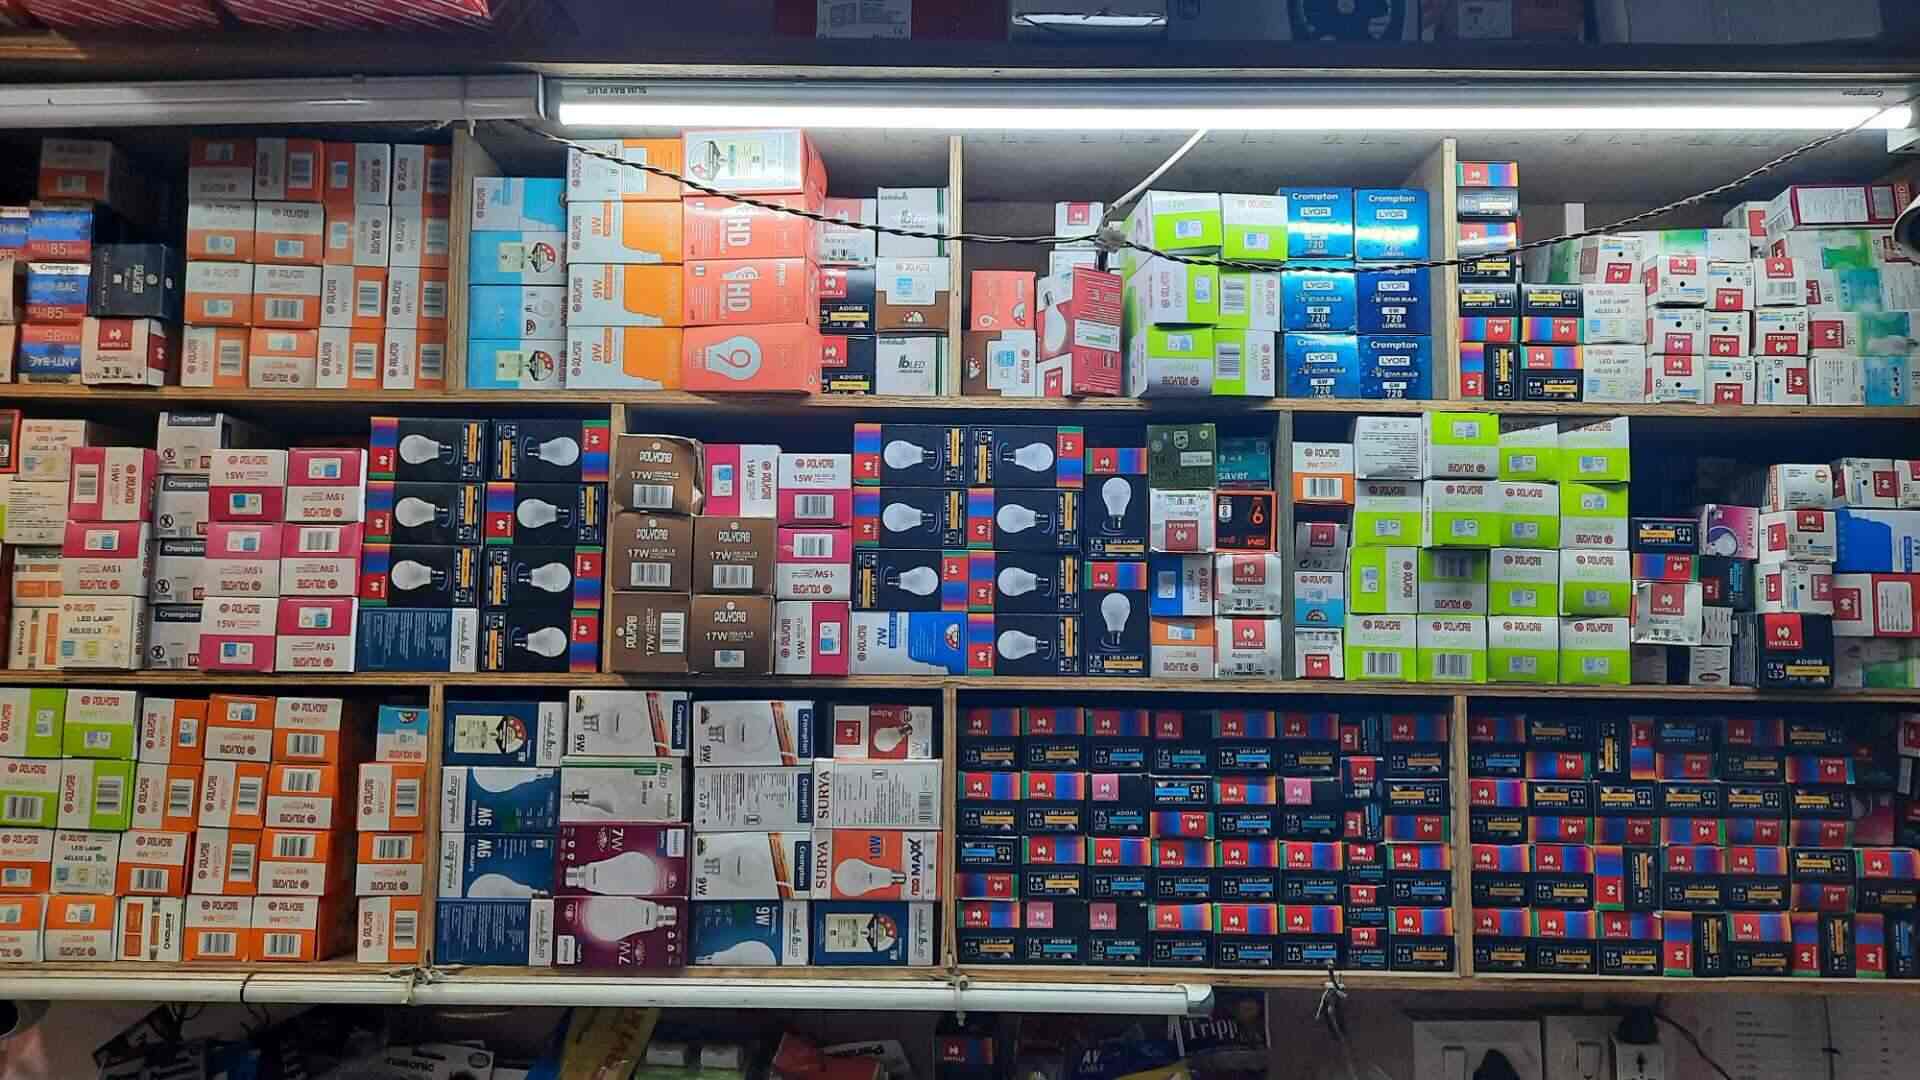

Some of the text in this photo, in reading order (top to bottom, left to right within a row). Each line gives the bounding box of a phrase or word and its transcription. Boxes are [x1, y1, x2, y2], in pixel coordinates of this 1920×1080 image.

[1293, 193, 1338, 201] Crompton
[1369, 195, 1415, 203] Crompton
[727, 284, 751, 312] HD
[1311, 314, 1326, 322] 720
[1371, 341, 1418, 349] Crompton
[1314, 386, 1330, 394] 720
[640, 451, 672, 463] POLYCAB
[631, 471, 652, 479] 17W
[1218, 471, 1248, 480] saver
[326, 493, 344, 501] 15W
[636, 528, 669, 540] POLYCAB
[718, 531, 751, 543] POLYCAB
[628, 549, 649, 558] 17W
[710, 551, 731, 560] 17W
[814, 570, 833, 578] 15W
[714, 611, 747, 623] POLYCAB
[217, 620, 236, 628] 15W
[626, 615, 637, 648] POLYCAB
[705, 632, 727, 640] 17W
[877, 627, 887, 646] 7W
[316, 643, 335, 651] 15W
[646, 633, 656, 655] 17W
[797, 640, 806, 660] 15W
[576, 734, 584, 752] 9W
[702, 744, 711, 762] 9W
[818, 770, 830, 819] SURYA
[478, 807, 493, 826] 9W
[612, 828, 624, 850] 7W
[478, 839, 492, 858] 9W
[869, 836, 881, 859] 10W
[816, 840, 829, 889] SURYA
[696, 877, 707, 896] 9W
[756, 906, 770, 925] 9W
[618, 941, 631, 965] 7W
